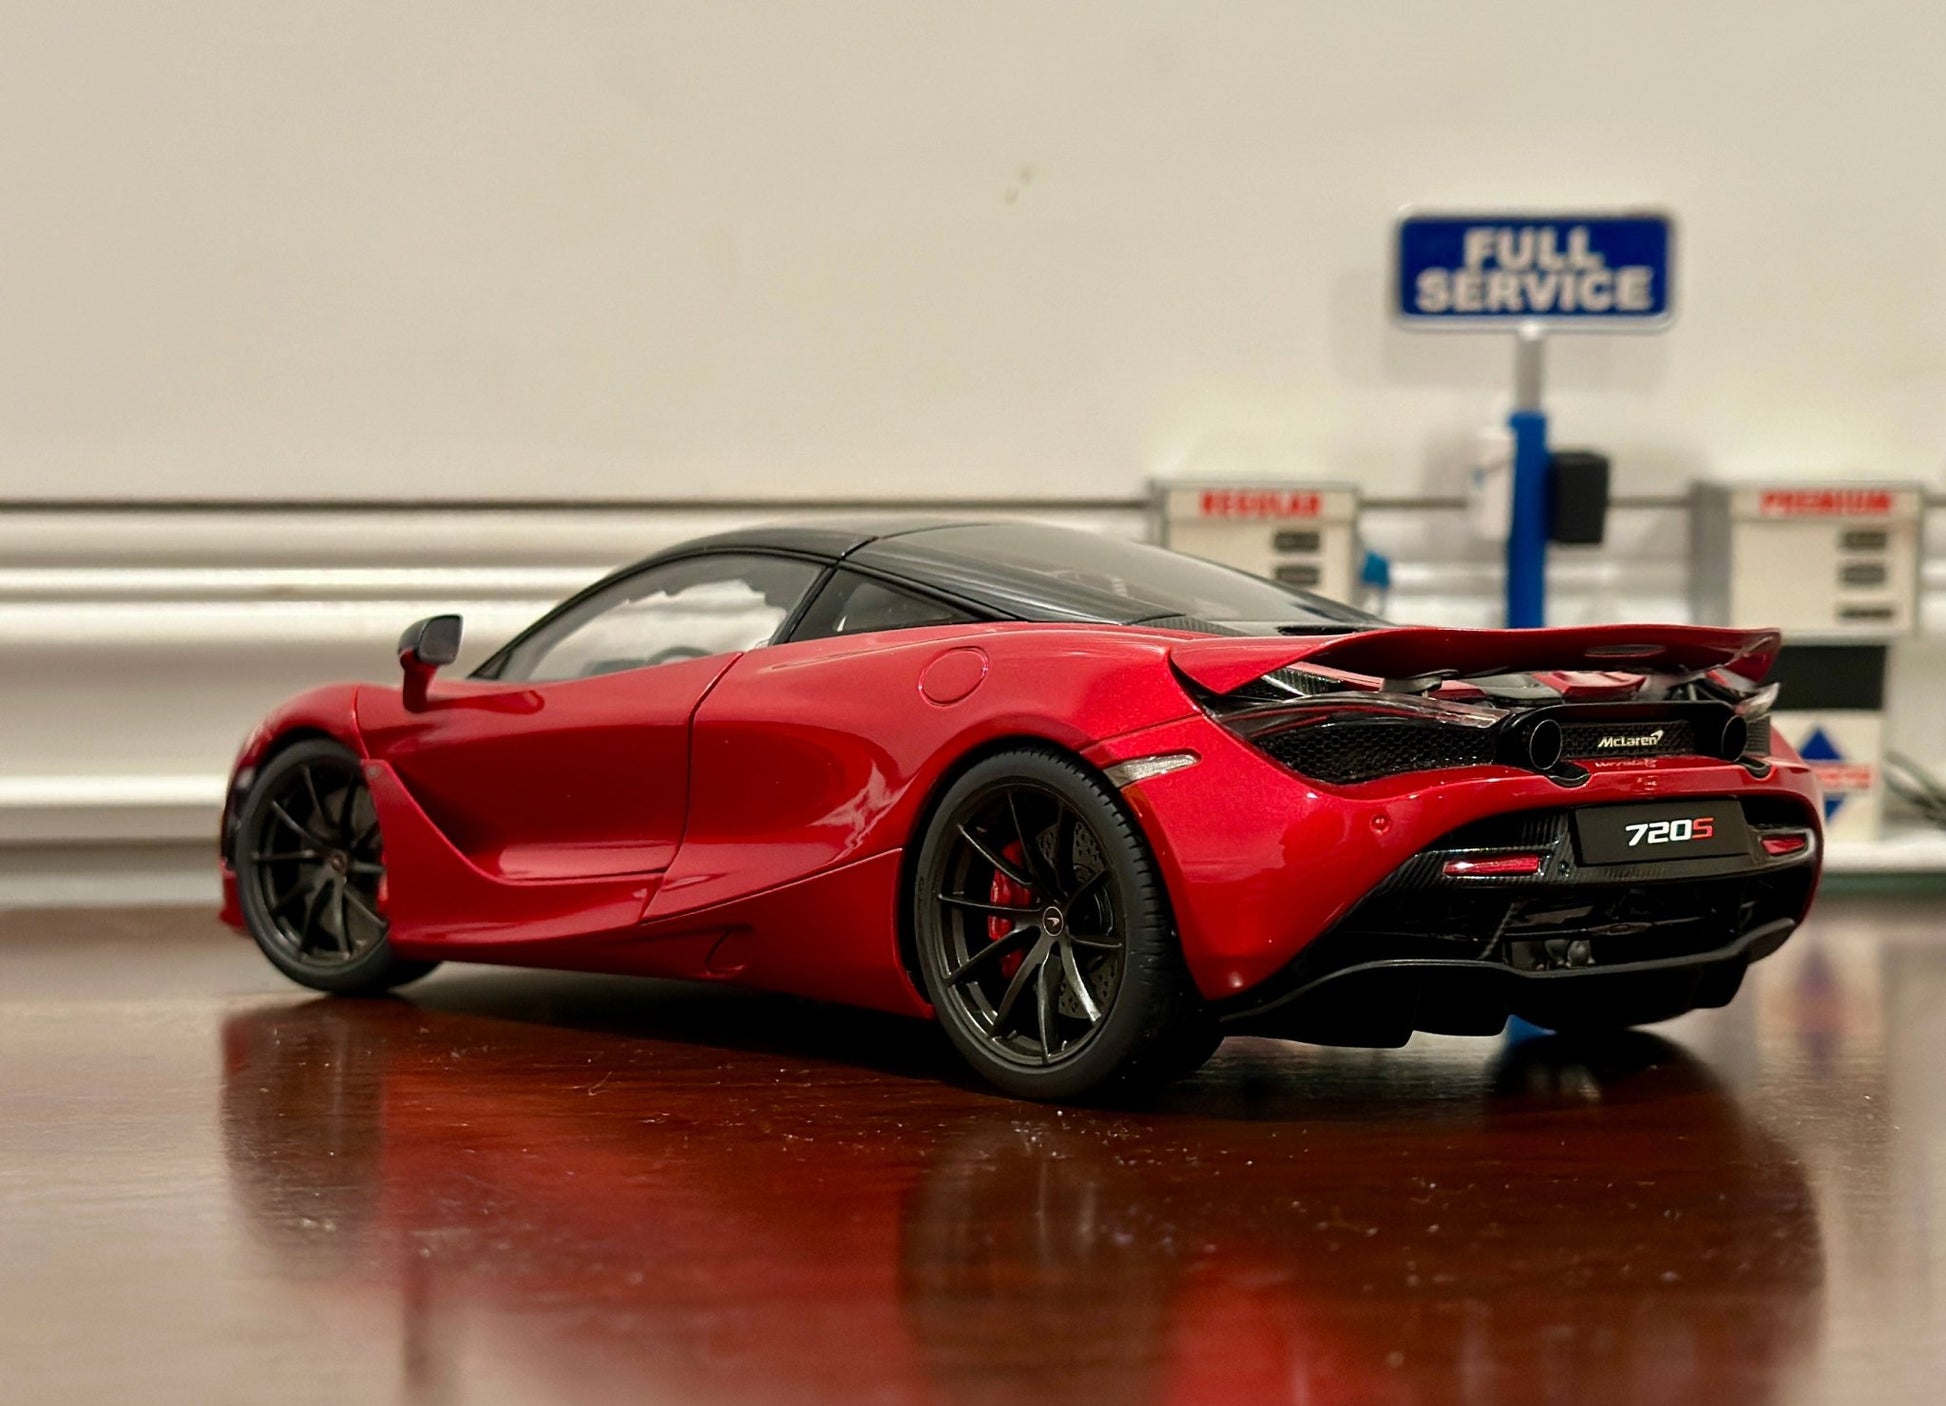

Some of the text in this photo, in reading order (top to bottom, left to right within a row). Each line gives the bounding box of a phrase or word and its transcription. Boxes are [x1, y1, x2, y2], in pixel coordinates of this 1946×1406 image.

[1463, 226, 1604, 271] FULL
[1415, 266, 1654, 312] SERVICE
[1598, 730, 1663, 748] McLaren
[1625, 818, 1714, 847] 720S
